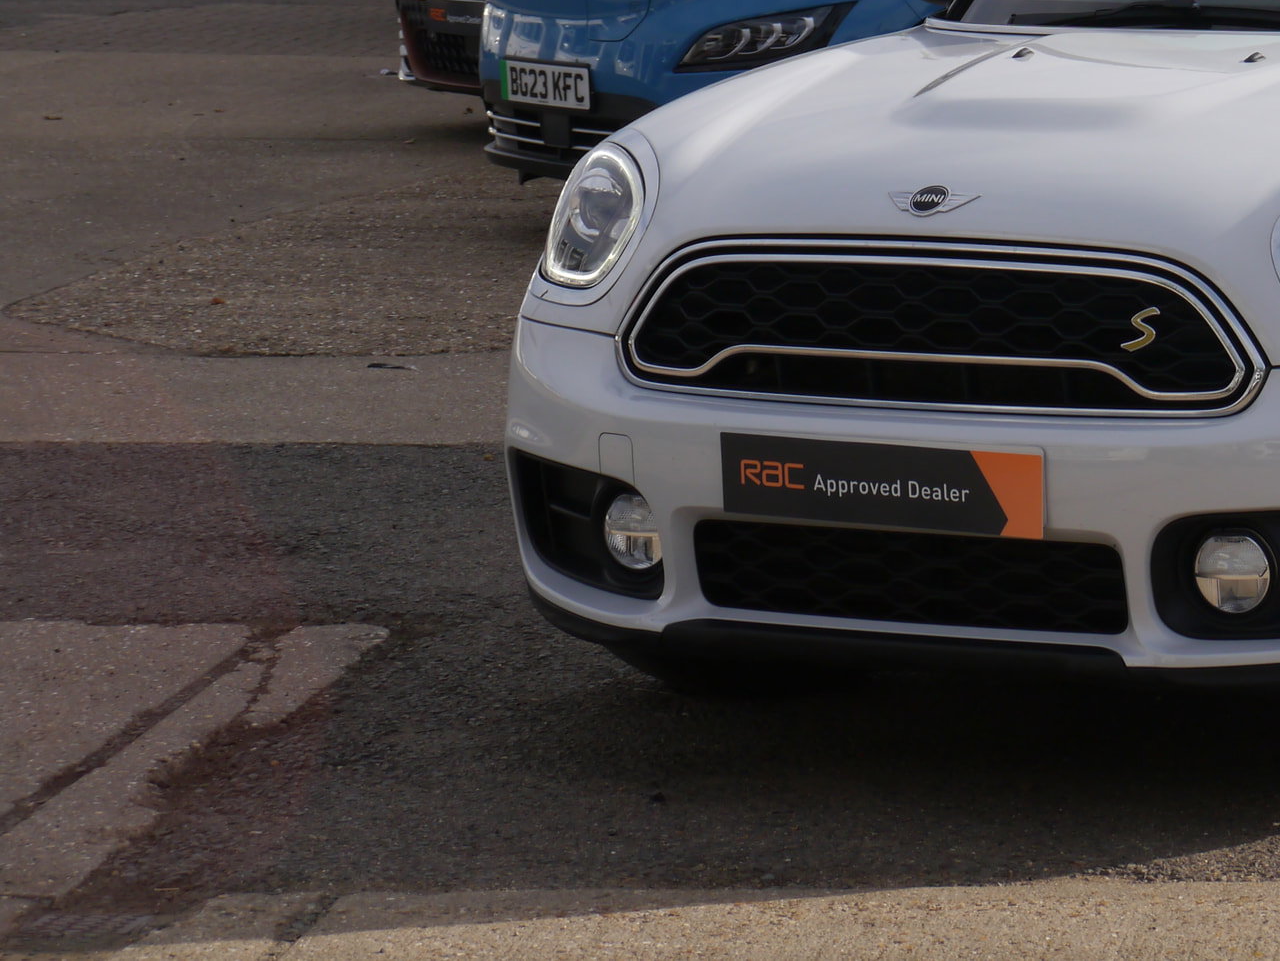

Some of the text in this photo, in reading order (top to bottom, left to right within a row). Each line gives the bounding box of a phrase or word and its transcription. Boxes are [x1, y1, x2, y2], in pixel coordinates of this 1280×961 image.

[510, 66, 585, 103] BG23 KFC
[914, 193, 945, 203] MINI
[1120, 307, 1160, 352] S
[813, 473, 901, 498] Approved
[908, 480, 970, 503] Dealer
